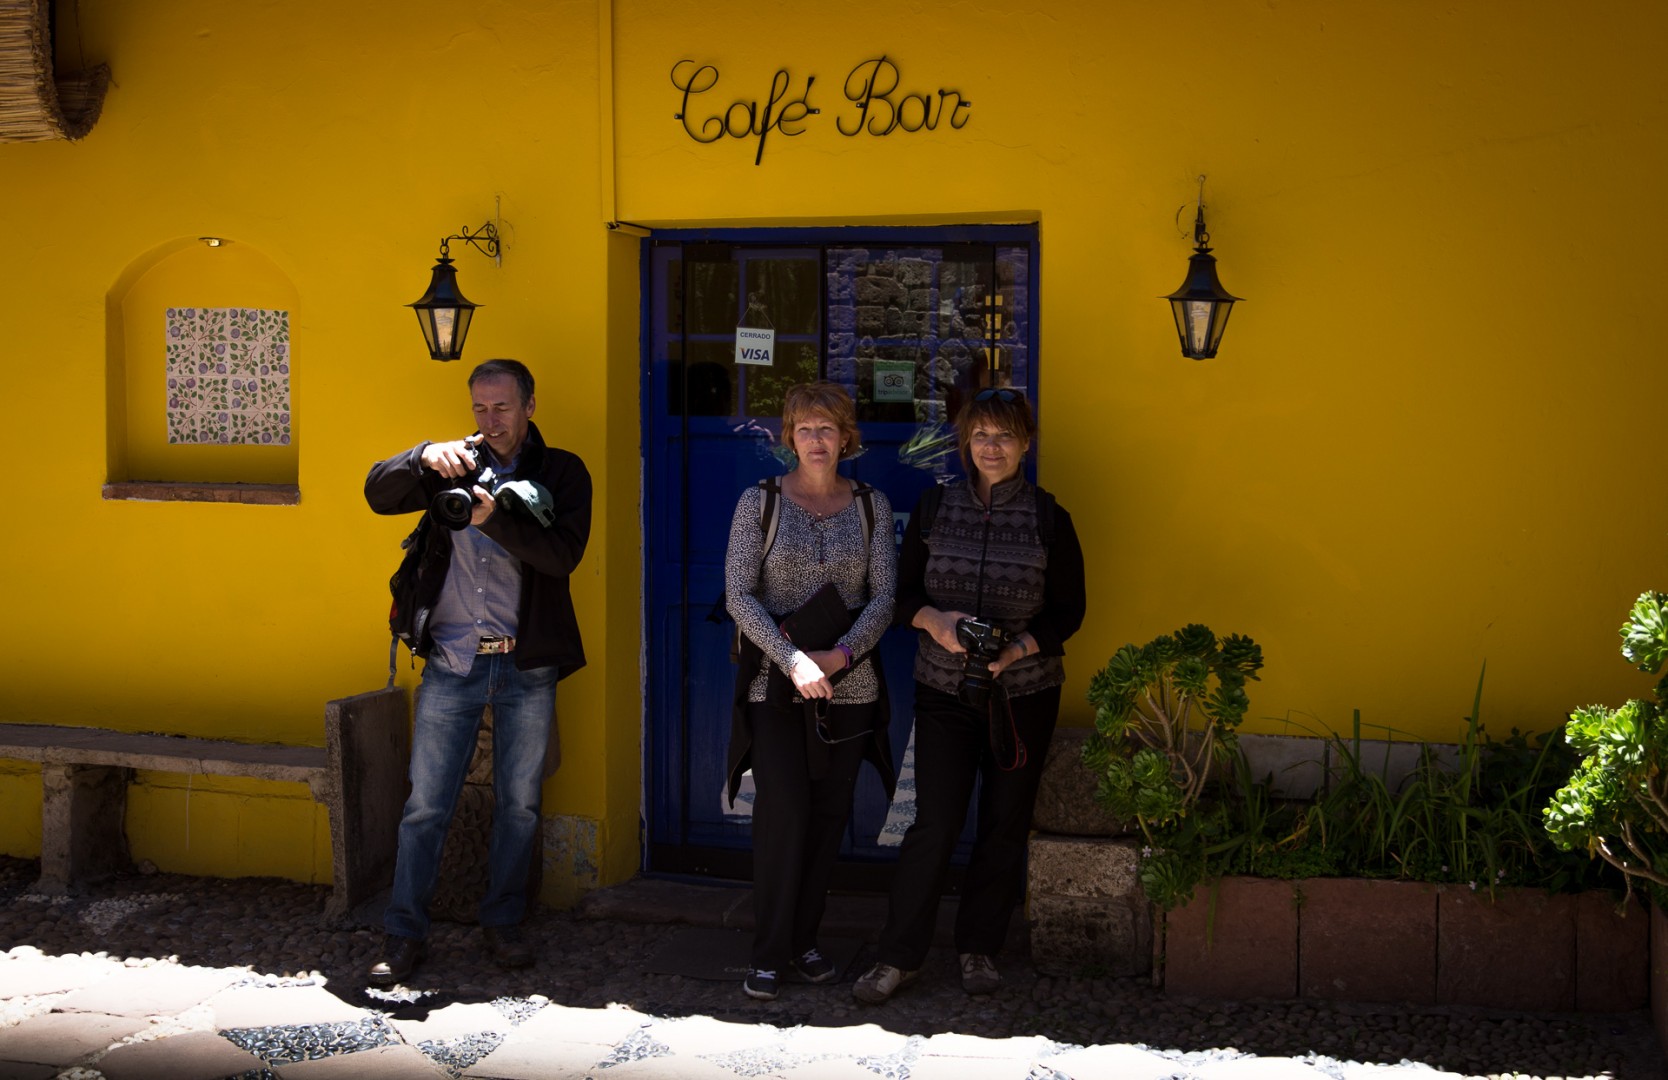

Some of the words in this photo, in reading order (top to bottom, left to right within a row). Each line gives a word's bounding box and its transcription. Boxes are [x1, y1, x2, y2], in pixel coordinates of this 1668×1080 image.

[671, 59, 817, 166] Café
[836, 56, 970, 136] Bar
[741, 347, 770, 360] VISA
